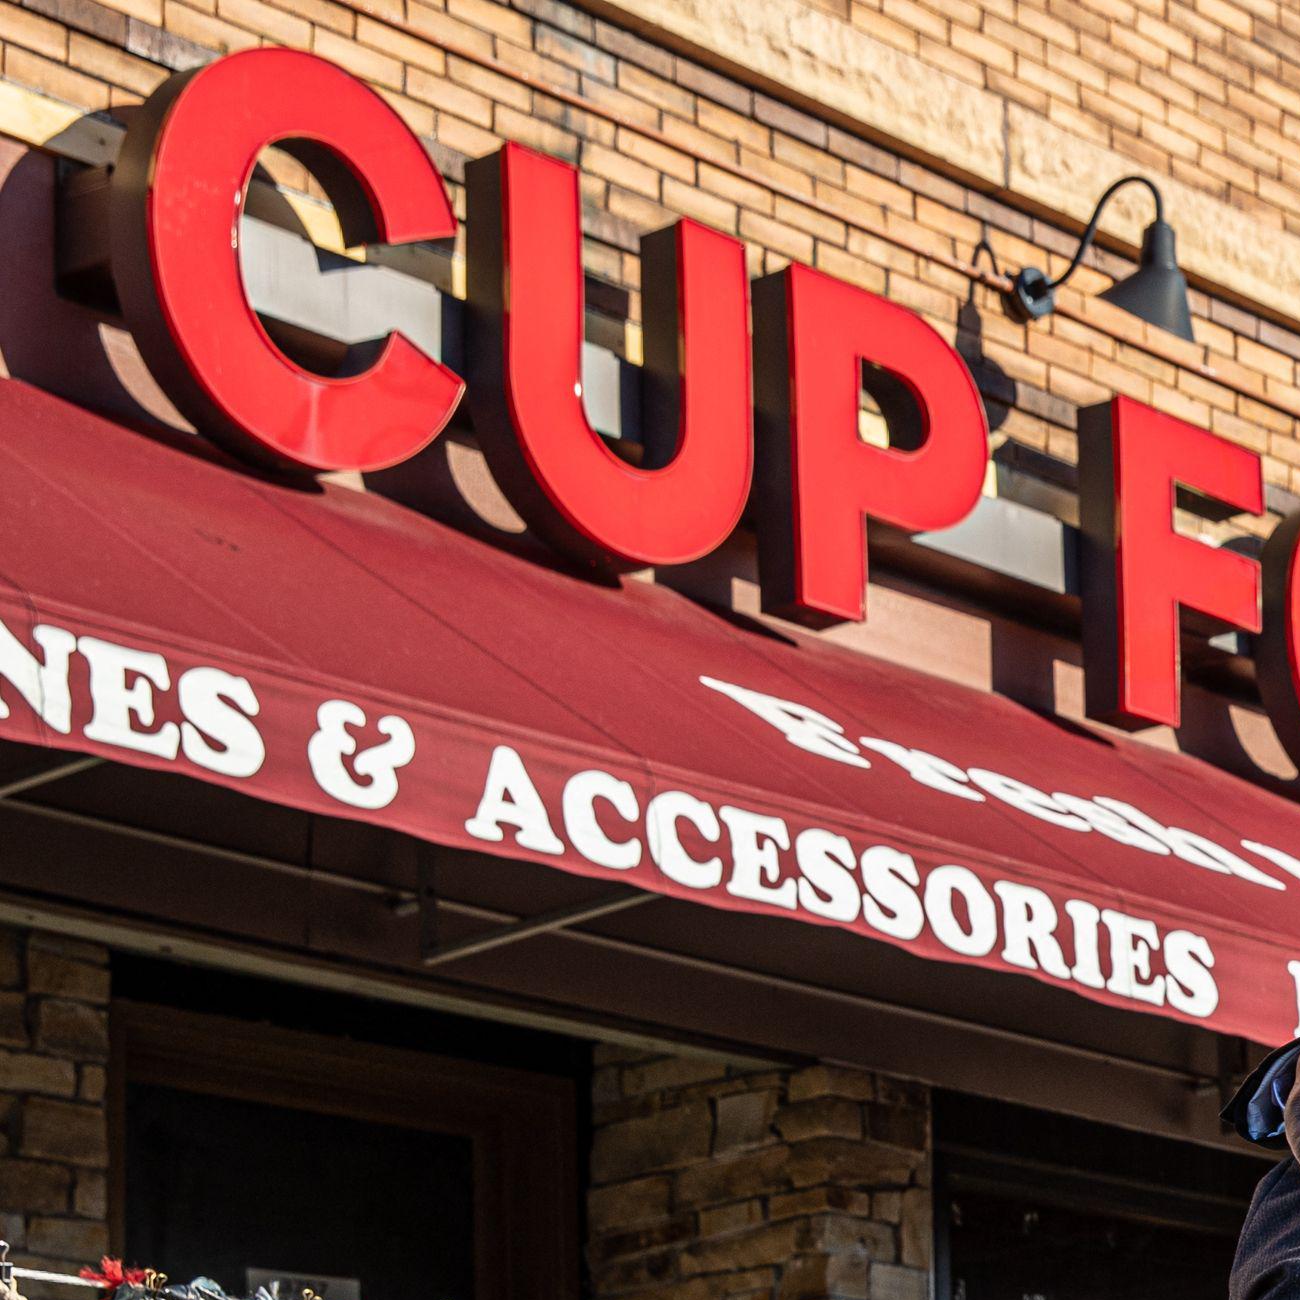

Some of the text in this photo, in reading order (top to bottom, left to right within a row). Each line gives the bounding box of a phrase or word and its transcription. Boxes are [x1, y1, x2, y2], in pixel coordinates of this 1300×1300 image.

[144, 46, 990, 626] CUP
[307, 699, 417, 810] &
[464, 745, 1219, 1018] ACCESSORIES
[699, 675, 1287, 891] Fresh
